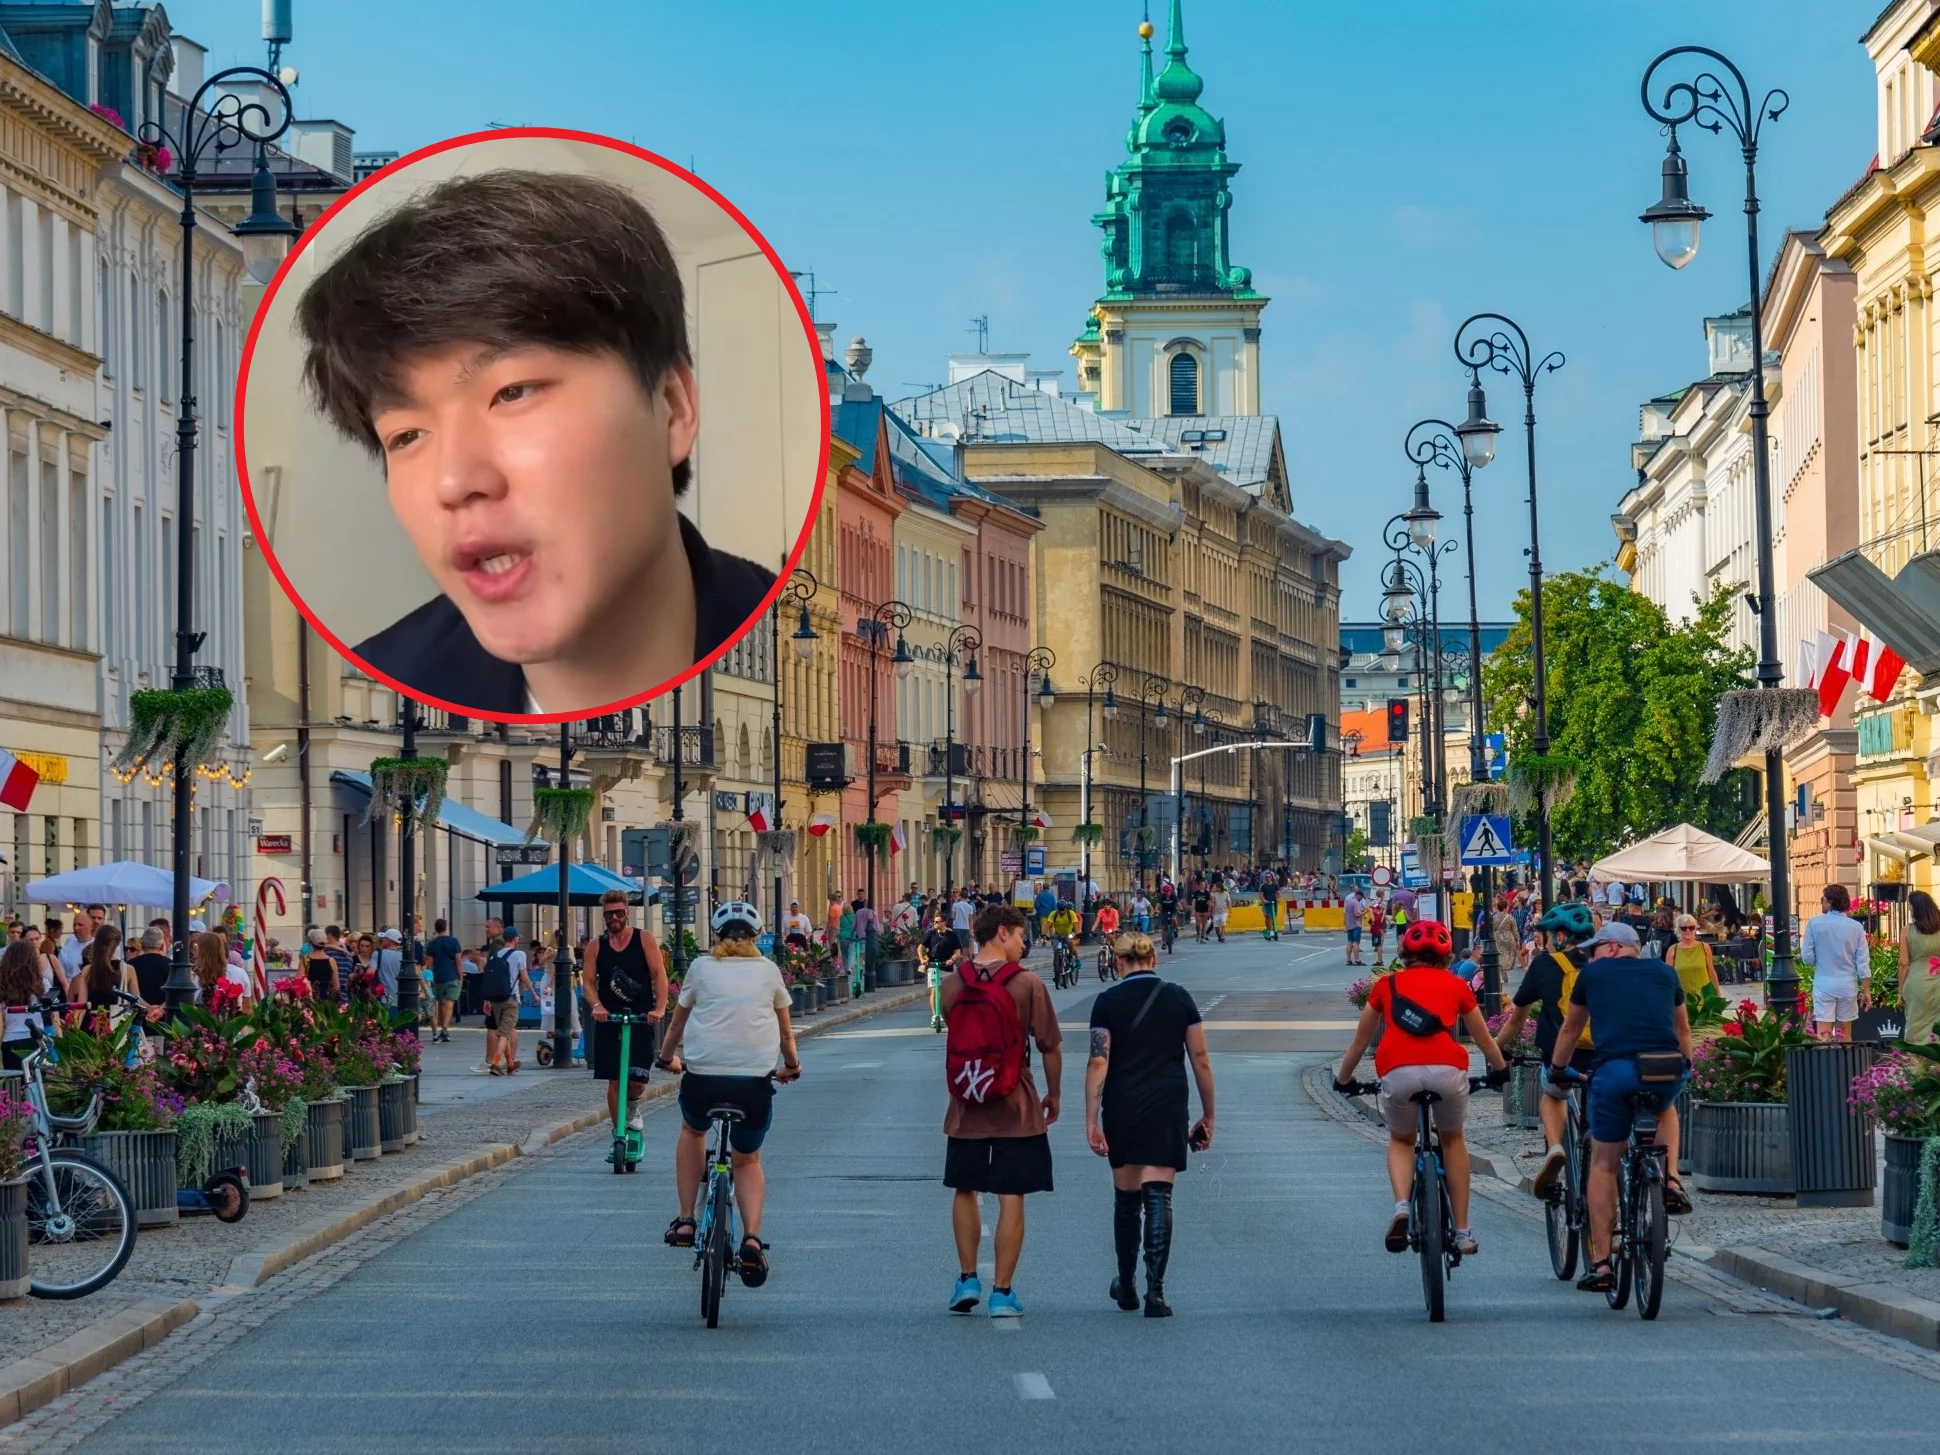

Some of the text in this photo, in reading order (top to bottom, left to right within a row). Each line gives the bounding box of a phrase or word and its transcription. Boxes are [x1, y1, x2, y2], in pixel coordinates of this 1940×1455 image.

[251, 826, 260, 834] 51
[260, 839, 289, 847] Warecka
[954, 1058, 996, 1105] NY
